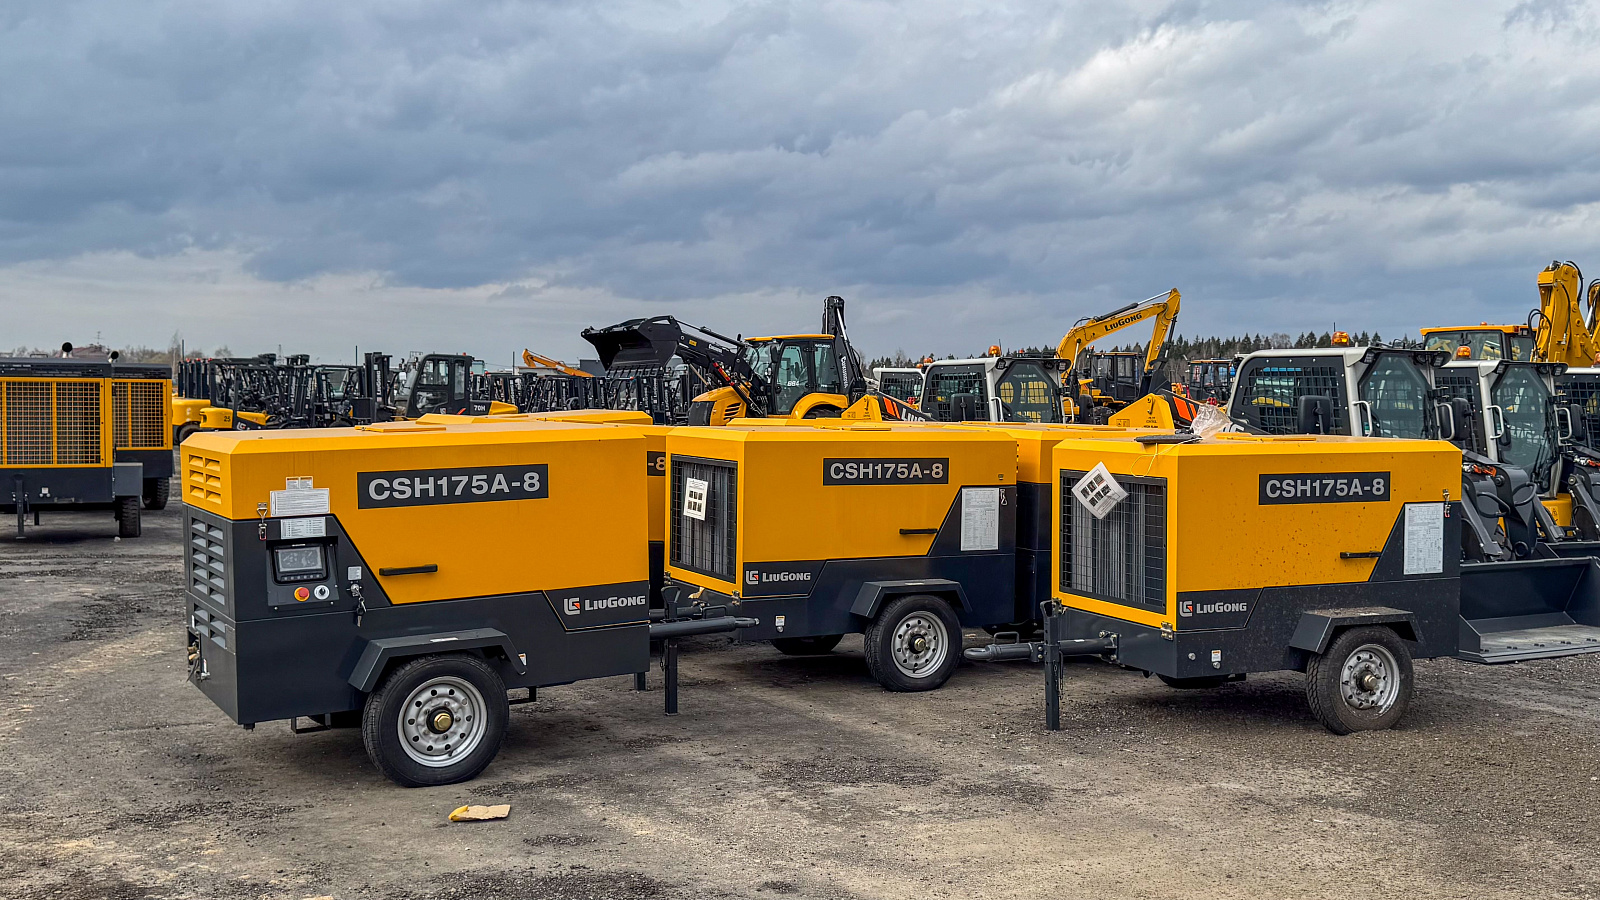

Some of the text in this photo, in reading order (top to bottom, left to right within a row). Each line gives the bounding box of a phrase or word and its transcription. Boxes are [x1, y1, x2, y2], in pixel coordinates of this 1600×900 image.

[829, 462, 944, 480] CSH175A-8
[368, 471, 541, 501] CSH175A-8
[1265, 478, 1385, 498] CSH175A-8
